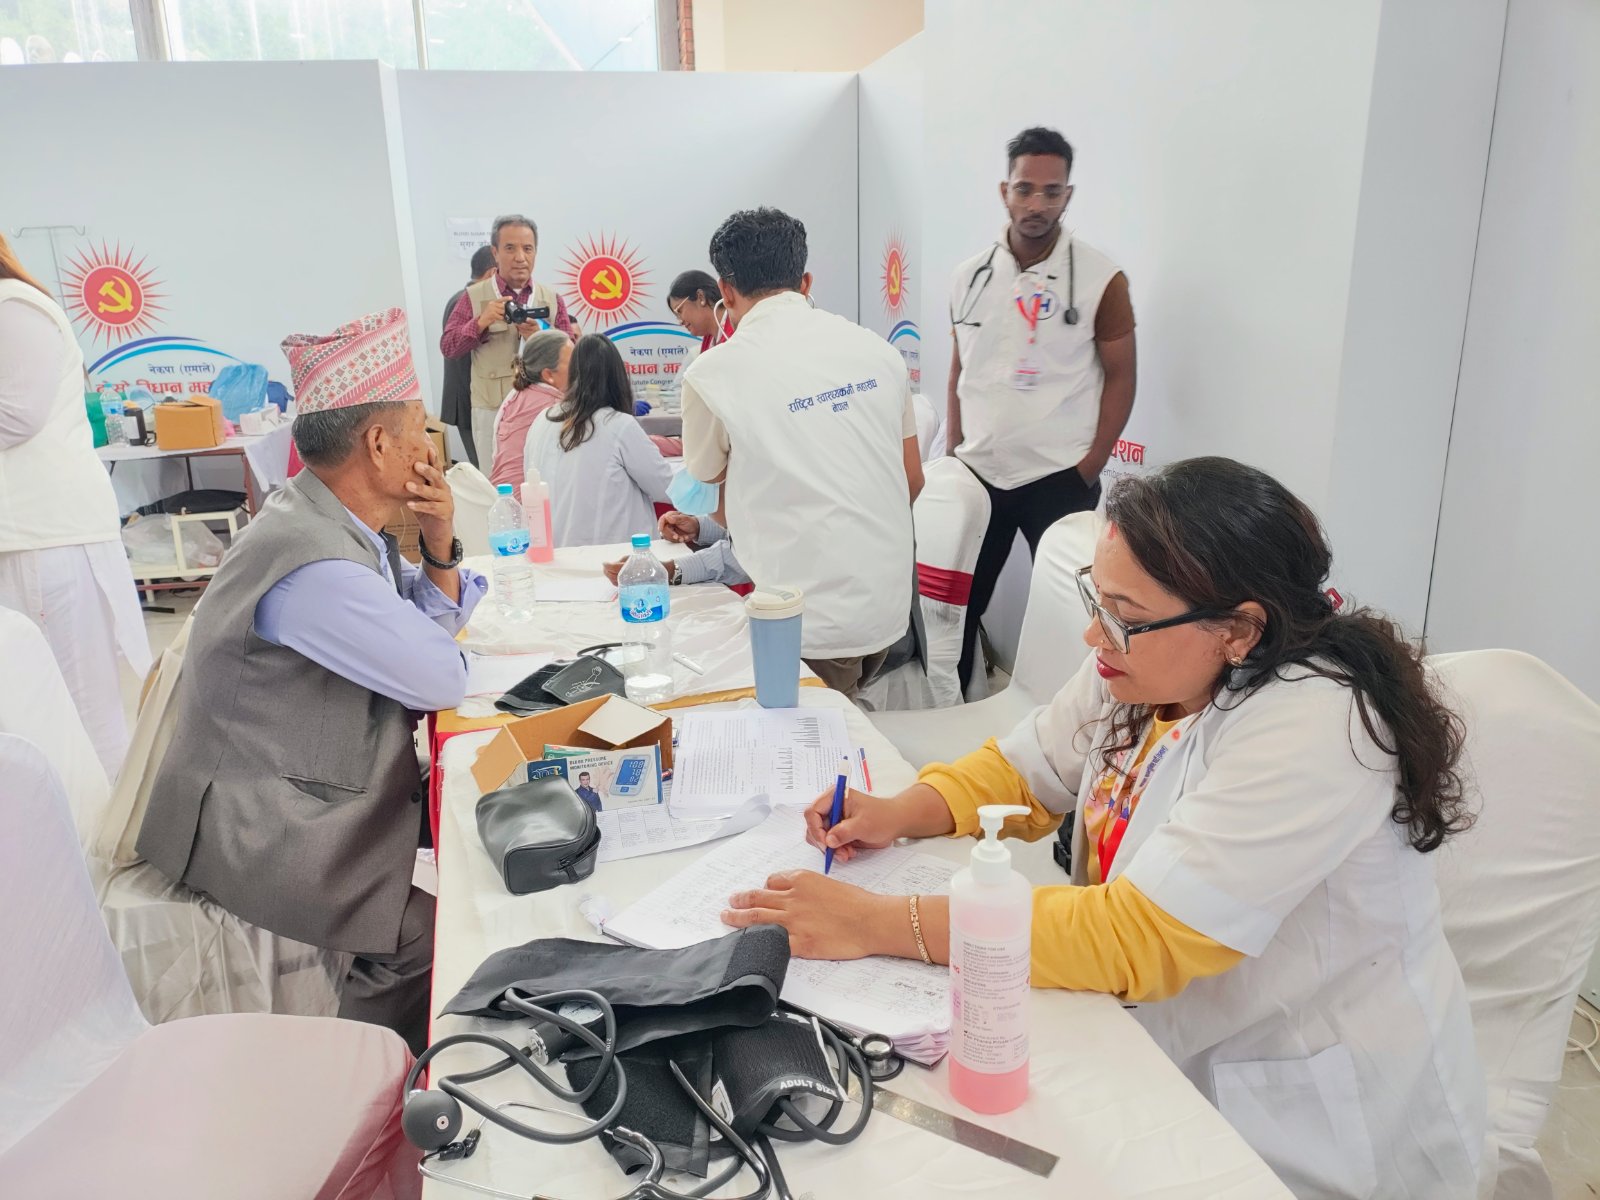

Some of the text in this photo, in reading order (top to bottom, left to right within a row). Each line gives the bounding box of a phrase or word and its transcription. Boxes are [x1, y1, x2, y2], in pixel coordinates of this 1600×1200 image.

[629, 346, 653, 356] नेकपा
[148, 363, 175, 374] नेकपा
[831, 401, 849, 413] नेपाल
[780, 1079, 813, 1090] ADULT
